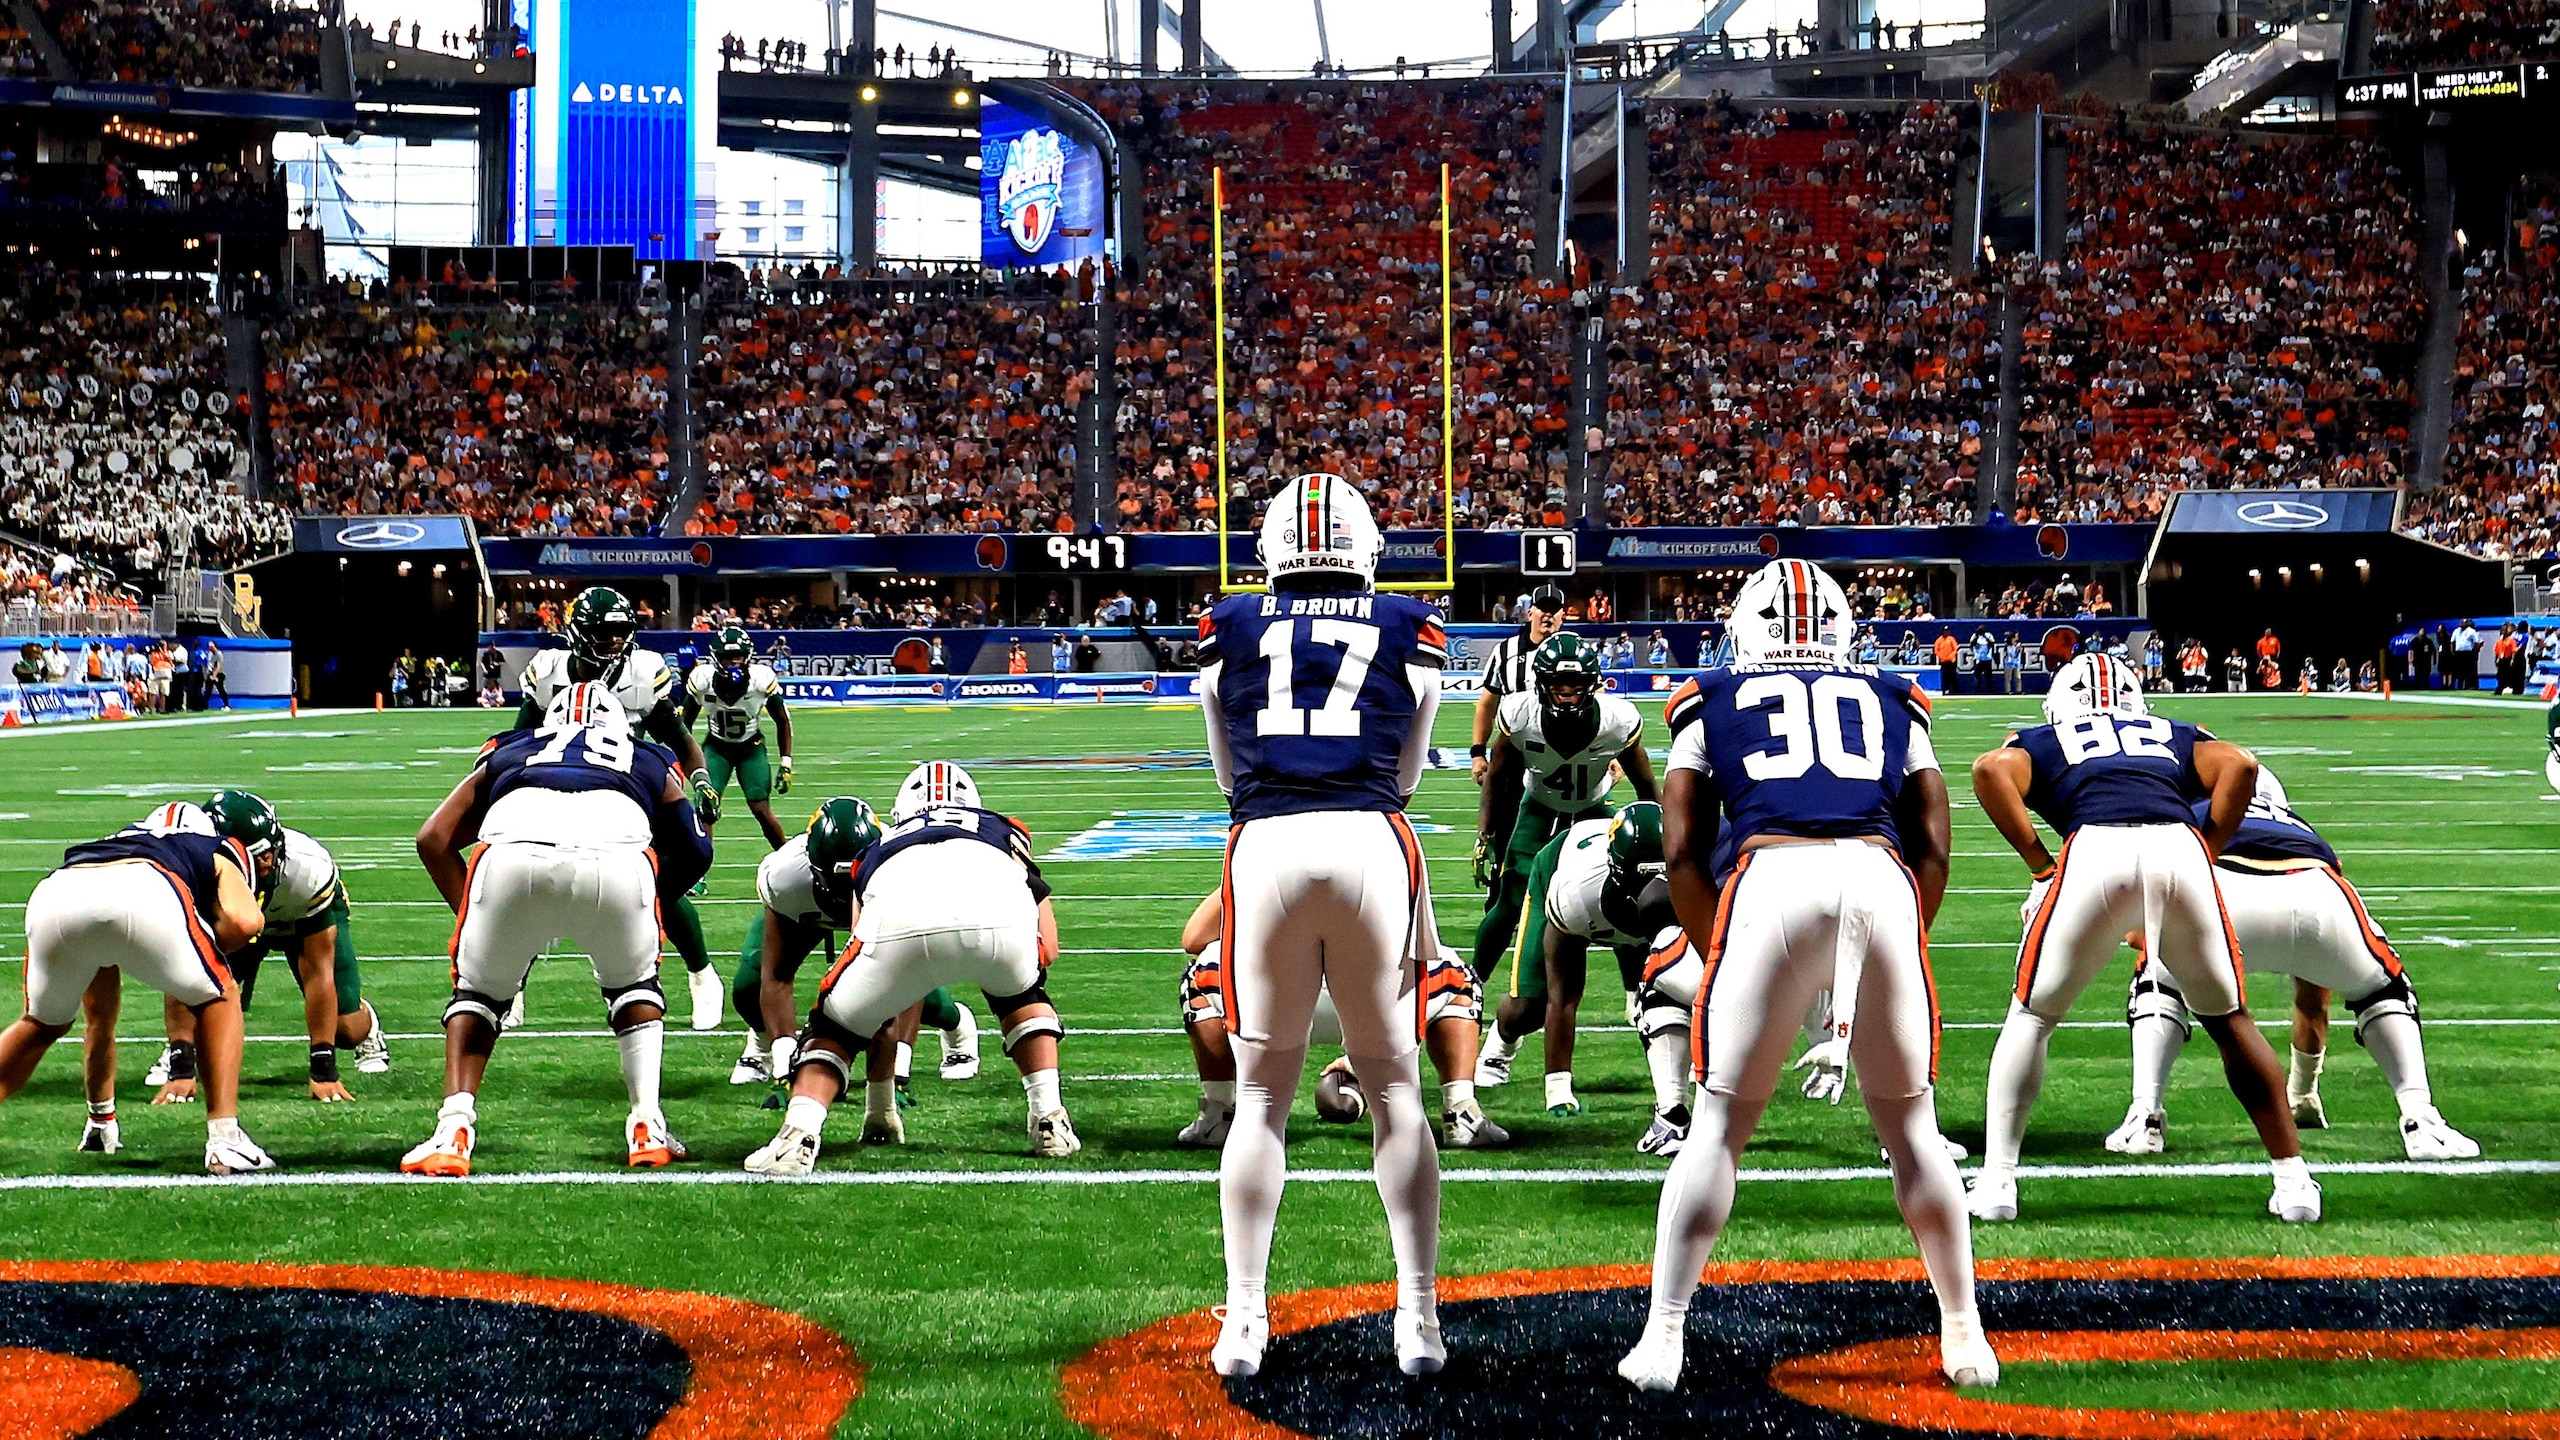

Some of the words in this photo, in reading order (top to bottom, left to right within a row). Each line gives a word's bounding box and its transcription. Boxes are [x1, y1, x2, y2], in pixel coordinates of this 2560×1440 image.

[2435, 73, 2467, 87] NEED
[2467, 70, 2504, 84] HELP?
[600, 83, 684, 104] DELTA
[2345, 85, 2378, 102] 4:37
[2382, 82, 2408, 99] PM
[2422, 87, 2450, 100] TEXT
[592, 550, 650, 563] KICKOFF
[1046, 536, 1126, 569] 9:47
[1395, 545, 1436, 557] GAME
[1537, 535, 1572, 569] 17
[1661, 543, 1717, 556] KICKOFF
[1719, 541, 1761, 555] GAME
[1278, 558, 1305, 572] WAR
[1309, 556, 1355, 570] EAGLE
[1260, 596, 1283, 617] B.
[1290, 596, 1374, 619] BROWN
[1764, 649, 1792, 660] WAR
[1796, 649, 1835, 662] EAGLE
[1256, 618, 1381, 738] 17
[961, 682, 1038, 696] HONDA
[715, 710, 747, 743] 15
[1734, 672, 1886, 782] 30
[526, 725, 634, 775] 79
[2053, 714, 2180, 766] 82
[1541, 763, 1589, 801] 41
